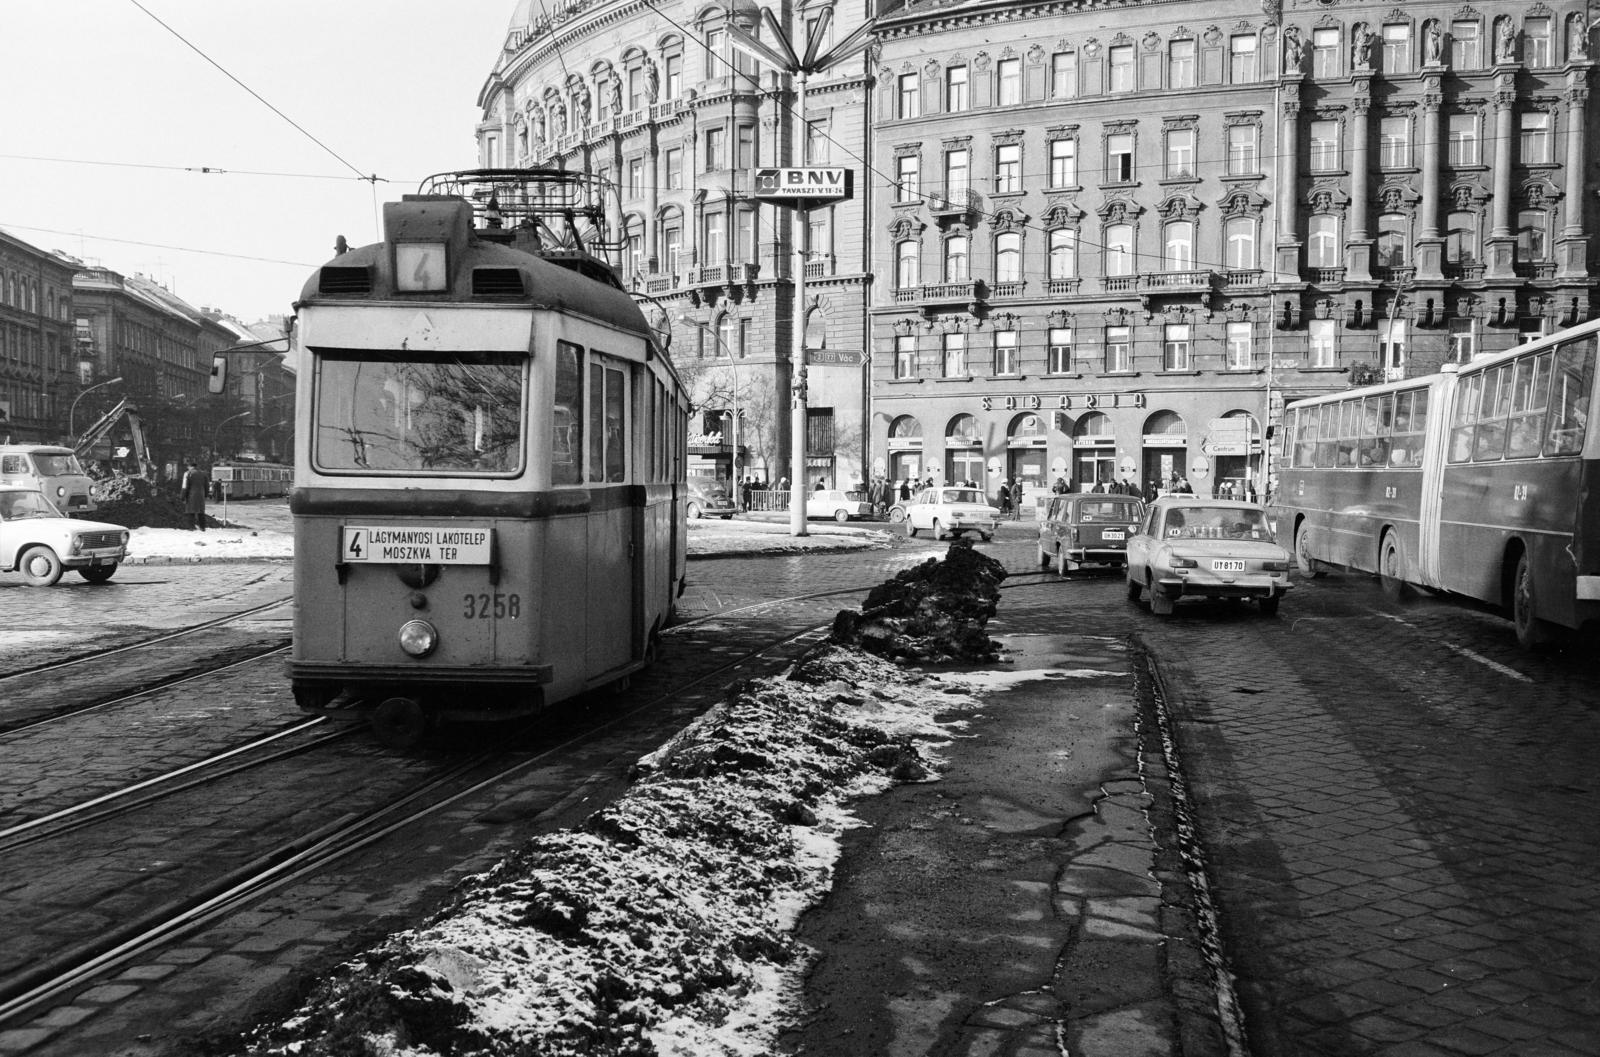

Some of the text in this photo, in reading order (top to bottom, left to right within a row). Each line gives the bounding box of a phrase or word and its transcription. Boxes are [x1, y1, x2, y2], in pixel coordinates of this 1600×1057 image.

[787, 171, 842, 185] BNV
[413, 253, 431, 290] 4
[838, 352, 854, 361] Vác
[349, 531, 362, 558] 4
[383, 546, 431, 560] MOSZKVA
[463, 593, 521, 619] 3258
